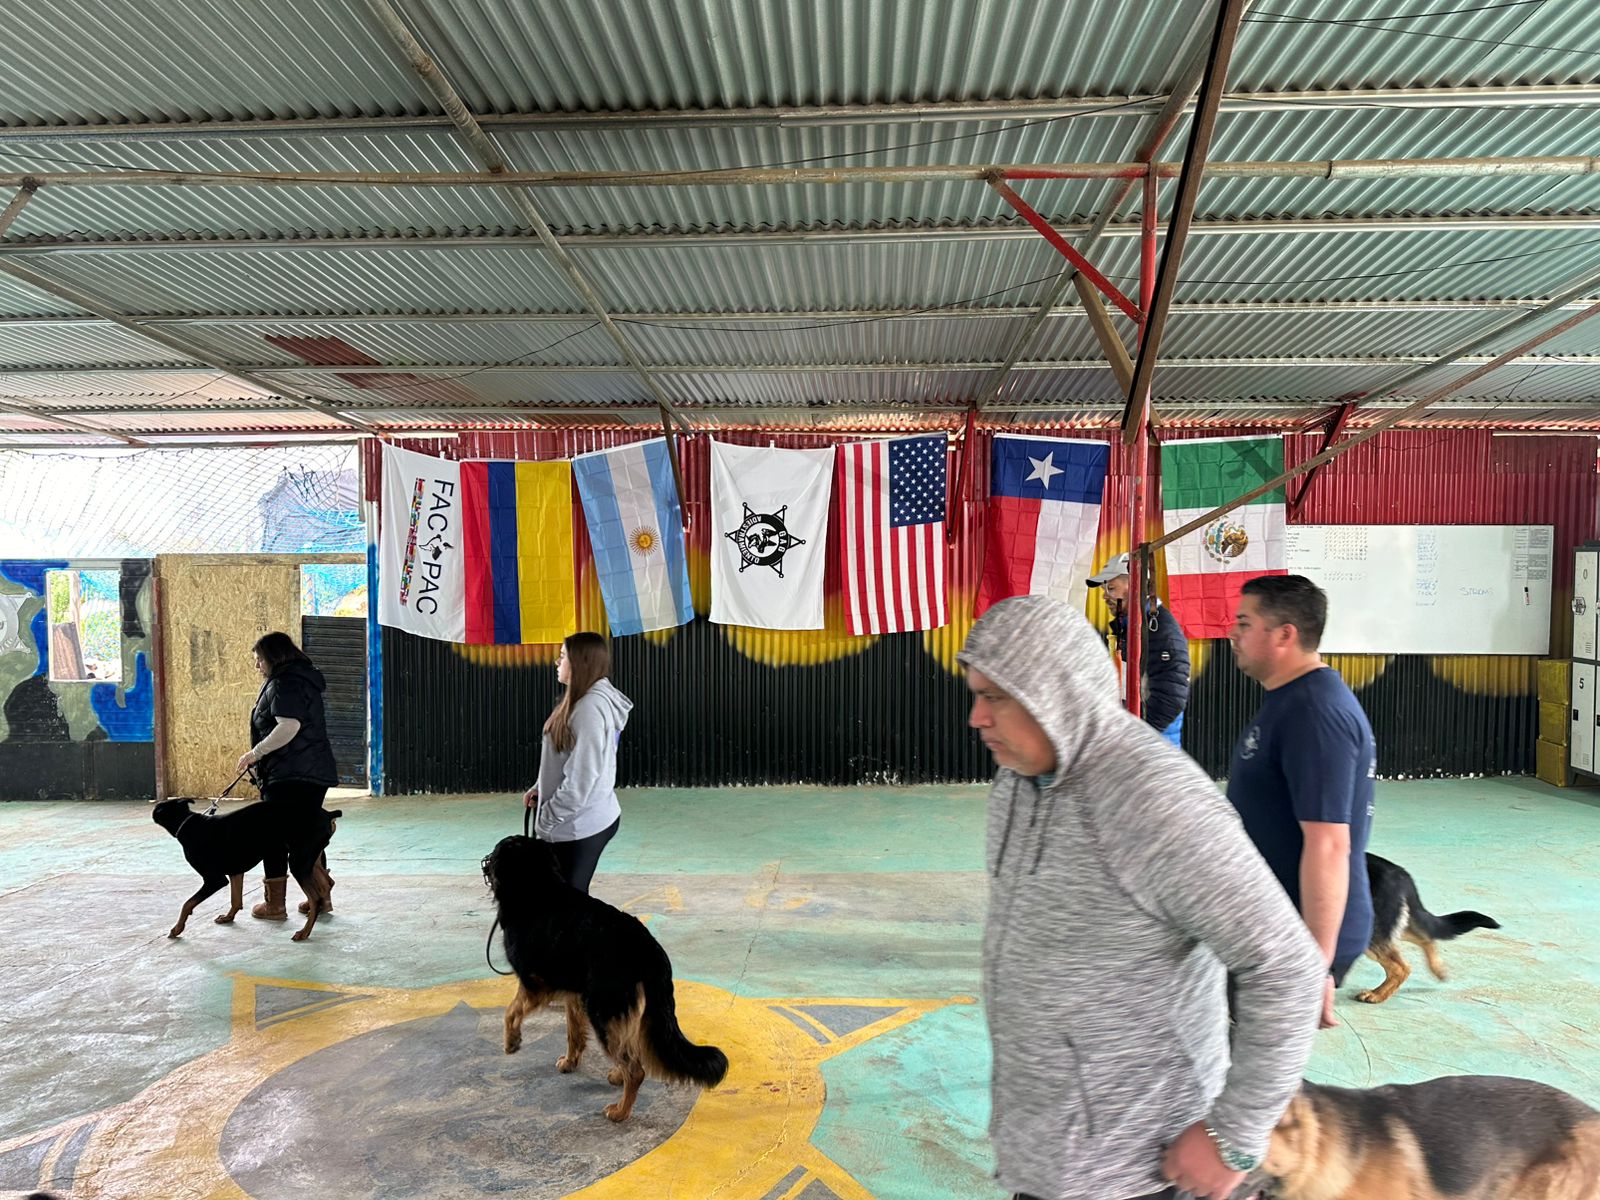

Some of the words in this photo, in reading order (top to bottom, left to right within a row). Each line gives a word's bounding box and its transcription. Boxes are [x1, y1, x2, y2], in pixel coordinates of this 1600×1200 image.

[427, 479, 455, 532] FAC
[737, 515, 762, 564] ADIESTRAMIENTO
[416, 561, 442, 615] PAC
[1578, 677, 1585, 690] 5
